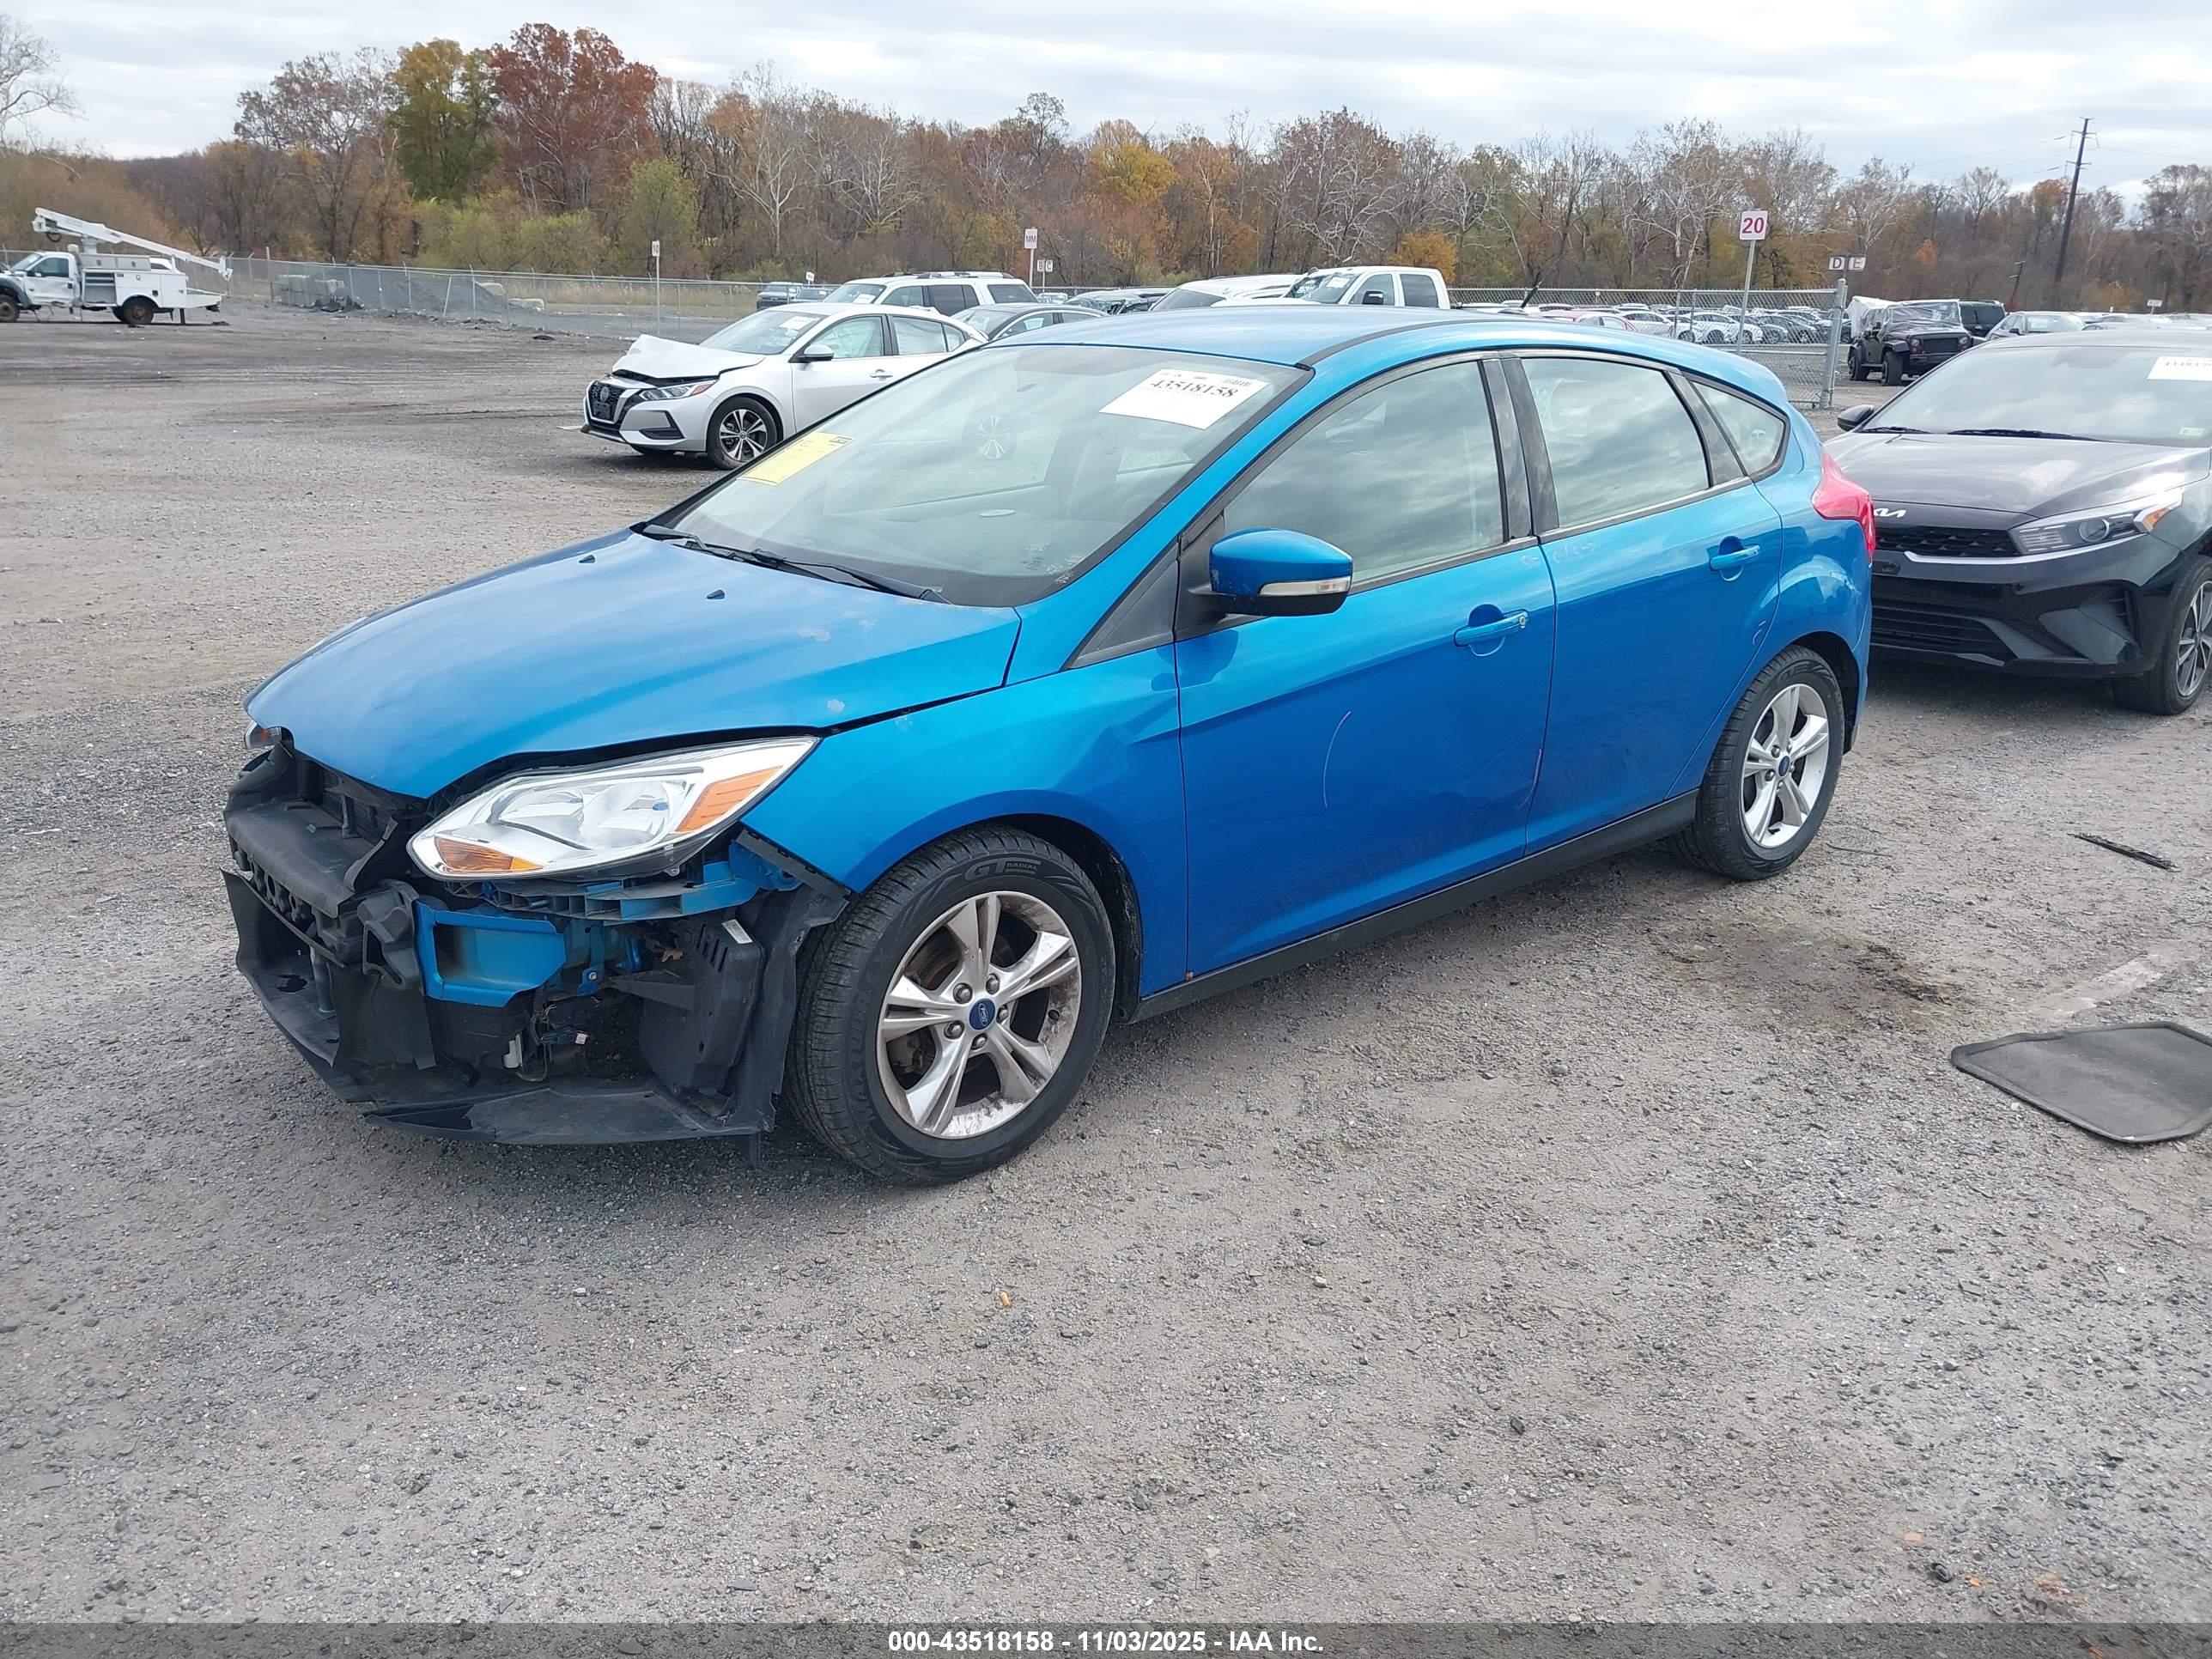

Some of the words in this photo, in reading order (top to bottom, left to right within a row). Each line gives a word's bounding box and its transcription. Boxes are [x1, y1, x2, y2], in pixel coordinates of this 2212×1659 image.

[1741, 216, 1765, 234] 20
[1038, 261, 1043, 270] B
[1047, 261, 1052, 270] C
[1832, 258, 1842, 269] D
[1853, 258, 1862, 269] E
[1151, 379, 1239, 398] 43518158
[1006, 862, 1037, 872] RADIAL
